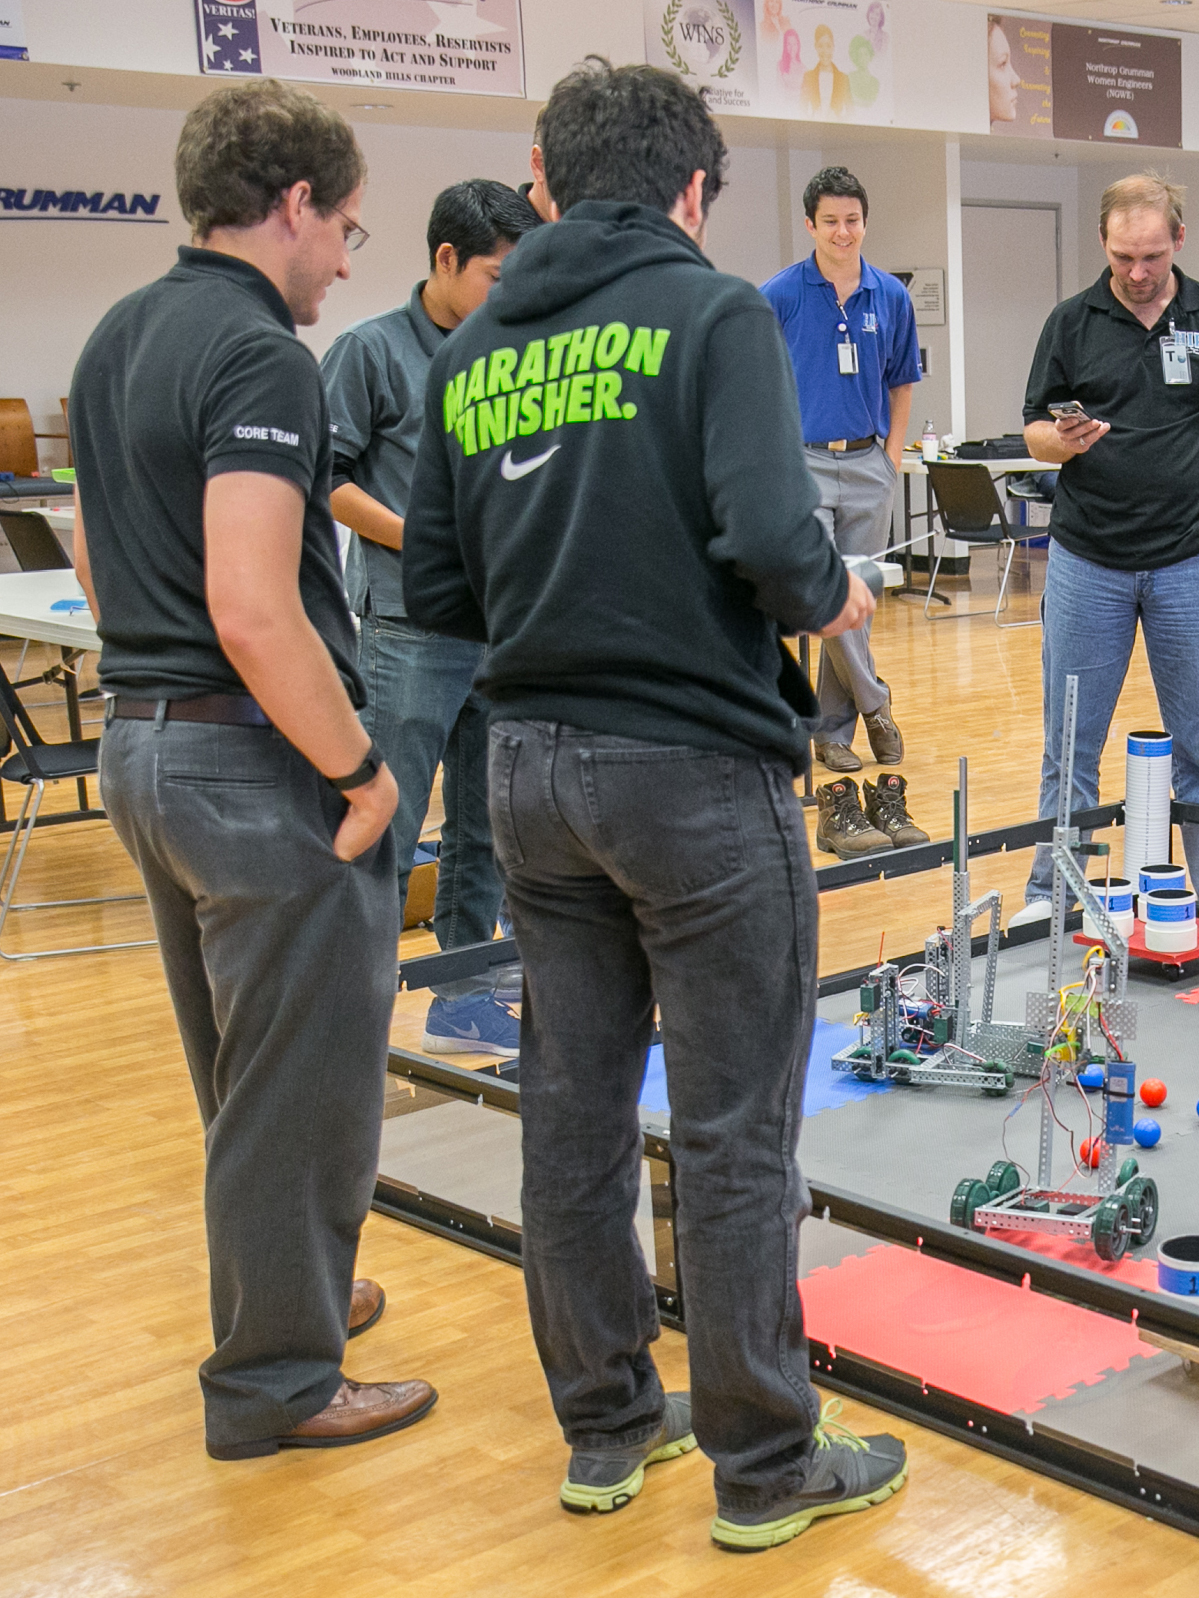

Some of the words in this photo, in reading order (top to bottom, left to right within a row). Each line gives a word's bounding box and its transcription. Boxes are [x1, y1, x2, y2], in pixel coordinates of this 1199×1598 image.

[204, 4, 256, 19] VERITAS!
[270, 18, 347, 40] VETERANS,
[351, 26, 432, 48] EMPLOYEES,
[436, 34, 511, 54] RESERVISTS
[679, 22, 725, 46] WINS
[290, 40, 355, 59] INSPIRED
[359, 48, 376, 60] TO
[381, 48, 406, 64] ACT
[410, 54, 436, 66] AND
[440, 54, 498, 71] SUPPORT
[332, 68, 382, 80] WOODLAND
[385, 71, 412, 82] HILLS
[414, 74, 456, 85] CHAPTER
[1086, 62, 1118, 76] Northrop
[1119, 66, 1154, 79] Grumman
[1087, 74, 1116, 86] Women
[1118, 79, 1153, 90] Engineers
[724, 97, 751, 107] Success
[1106, 89, 1134, 101] (NGWE)
[0, 188, 160, 215] RUMMAN
[1166, 351, 1175, 362] T
[443, 321, 671, 433] MARATHON
[235, 425, 268, 440] CORE
[271, 427, 299, 447] TEAM
[1143, 878, 1149, 892] 1
[1108, 898, 1114, 910] 1
[1184, 906, 1190, 918] 1
[1189, 1276, 1198, 1294] 1
